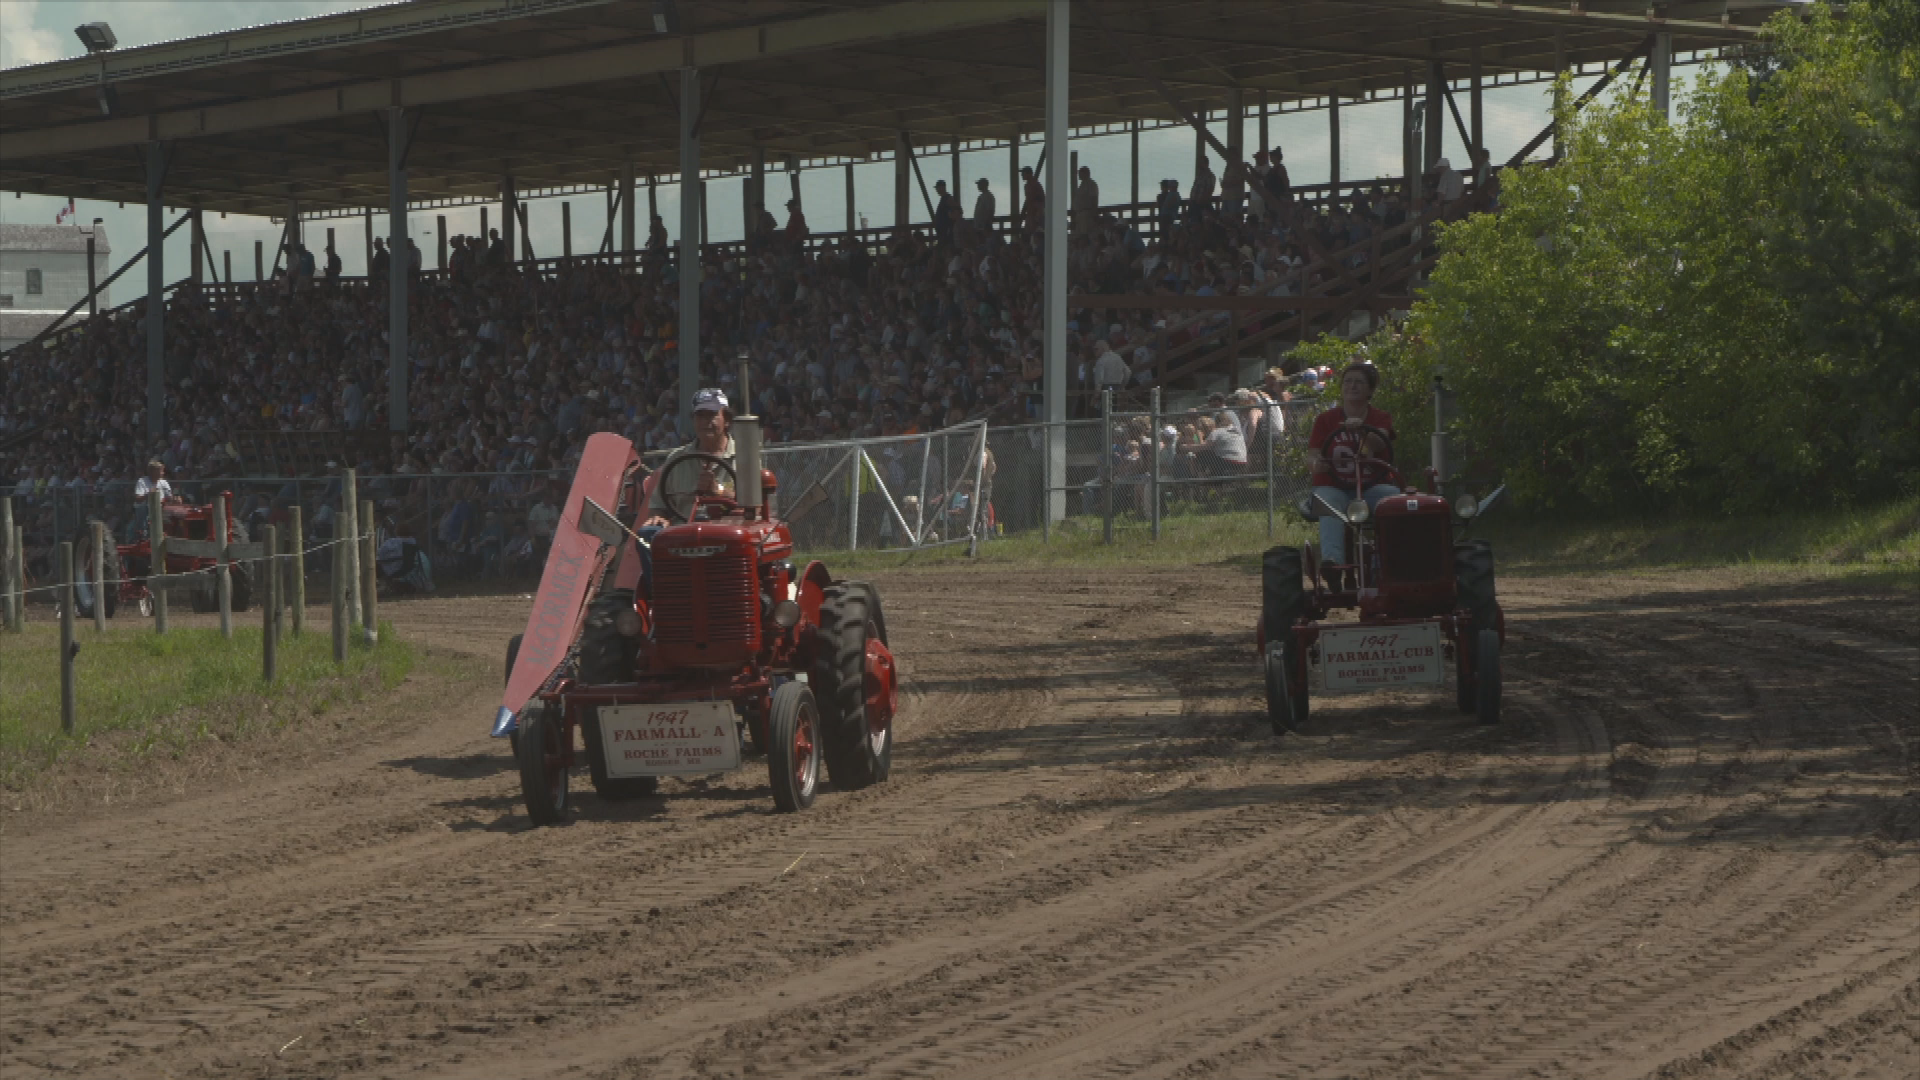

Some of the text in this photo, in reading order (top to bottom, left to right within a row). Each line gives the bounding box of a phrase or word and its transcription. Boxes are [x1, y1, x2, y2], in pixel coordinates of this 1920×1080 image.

[1360, 634, 1399, 649] 1947
[1338, 665, 1425, 679] ROCHE FARMS
[647, 710, 689, 726] 1947
[624, 746, 722, 759] ROCHE FARMS
